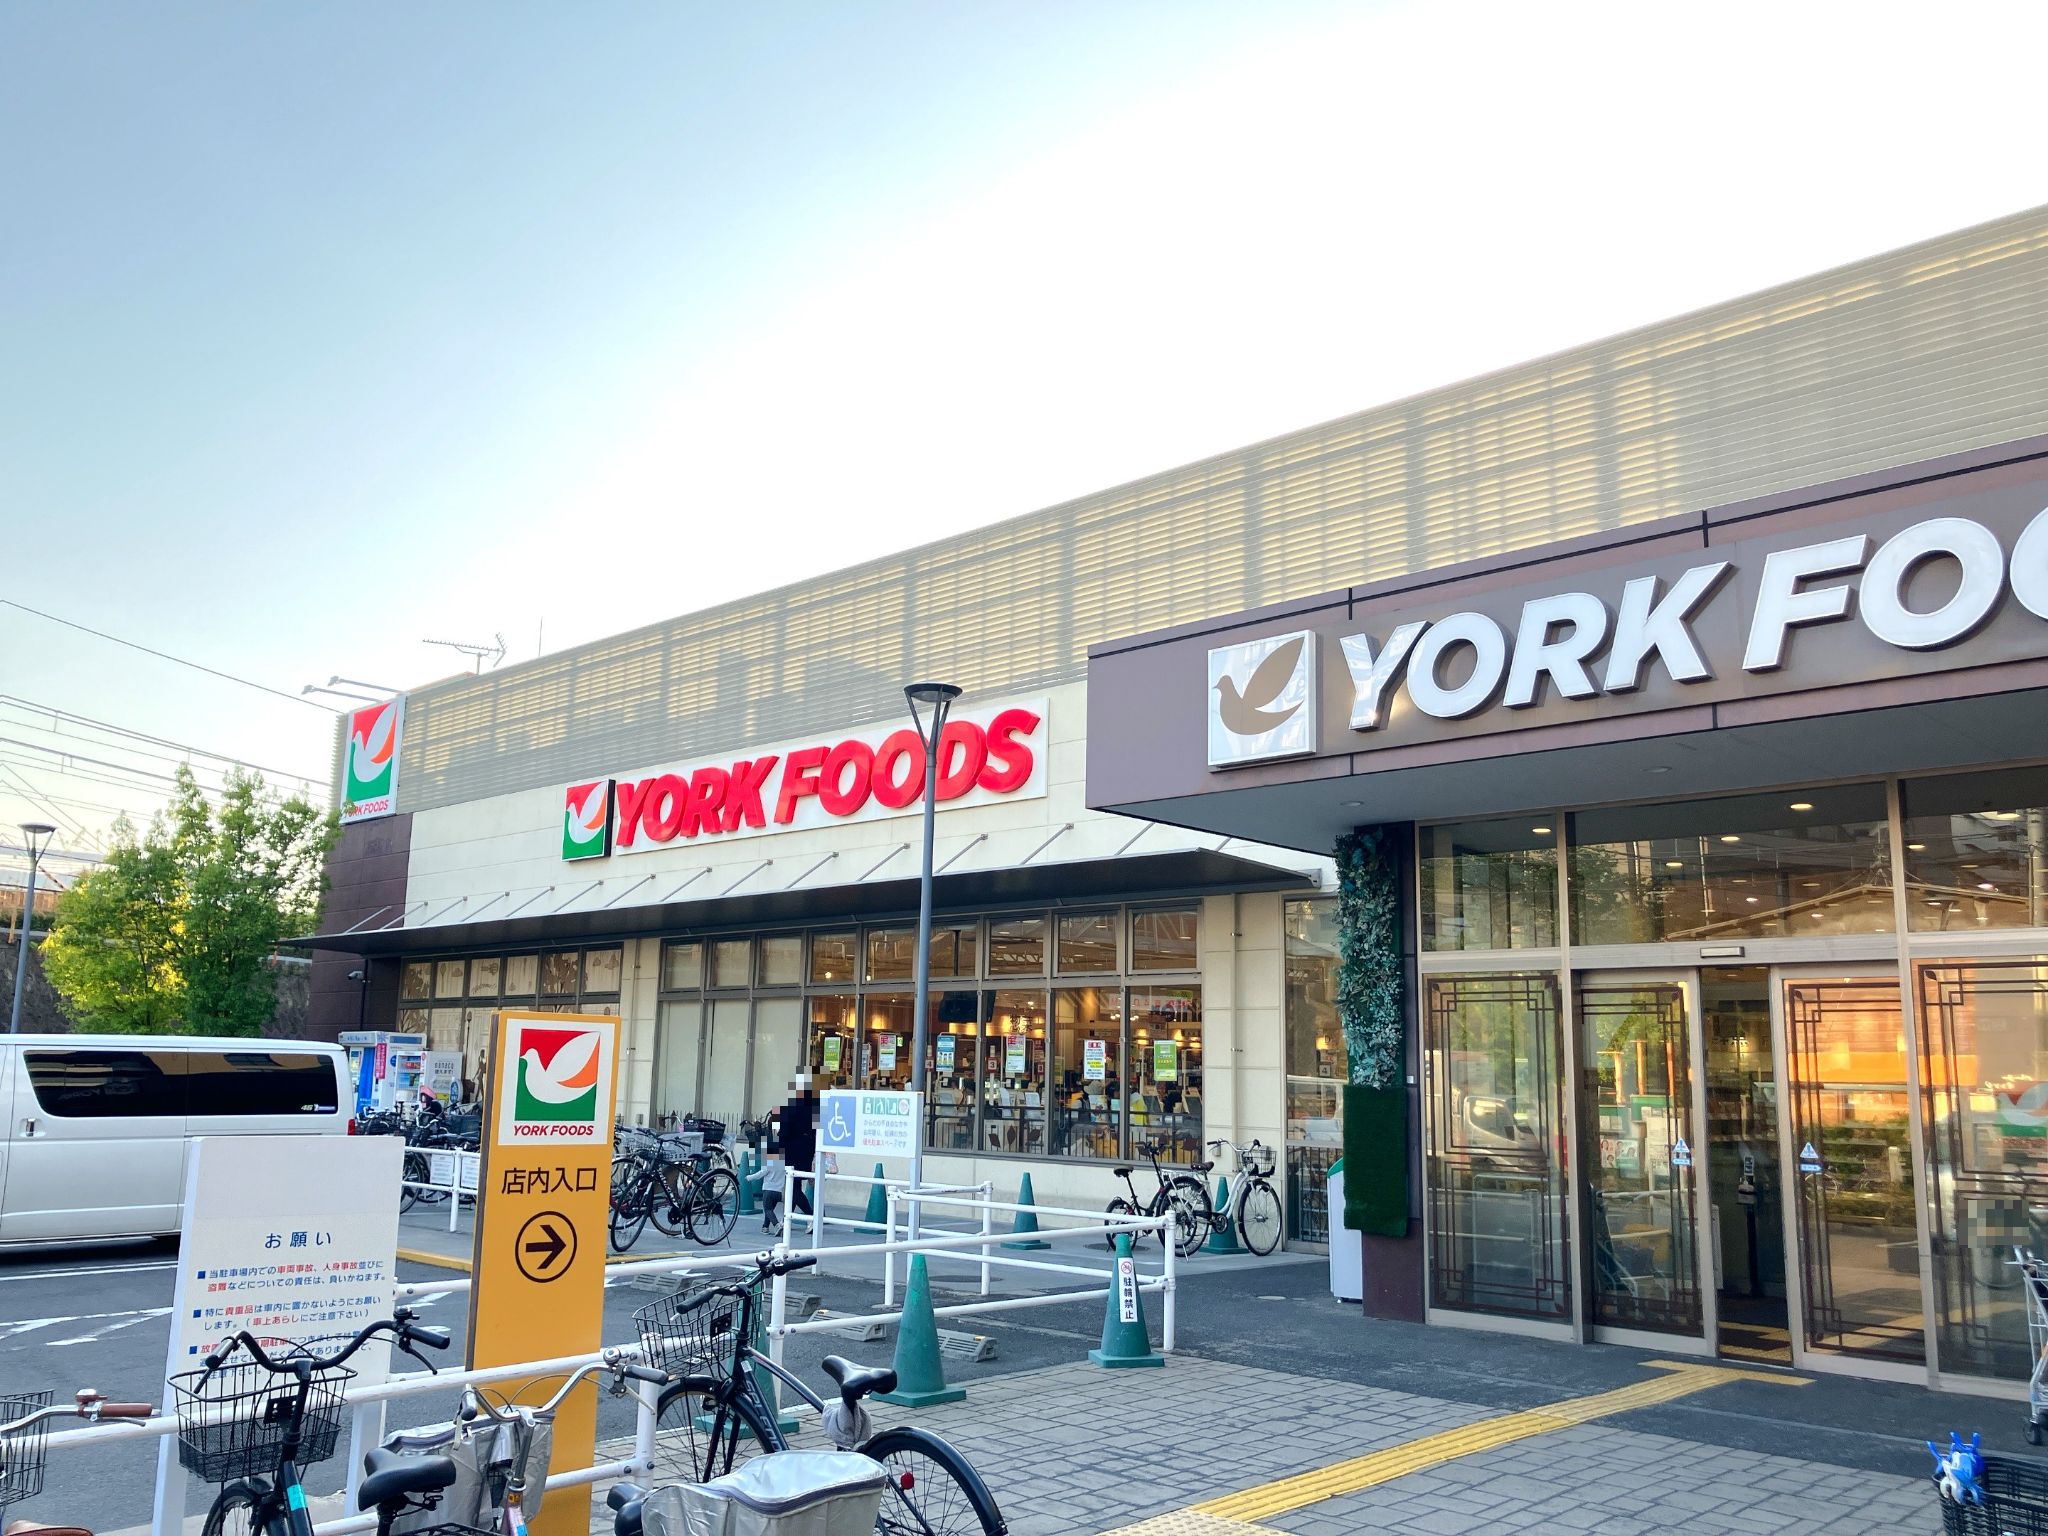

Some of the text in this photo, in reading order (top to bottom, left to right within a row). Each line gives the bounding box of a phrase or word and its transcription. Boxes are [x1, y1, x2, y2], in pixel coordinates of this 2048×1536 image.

[1338, 504, 2048, 732] YORK FO
[616, 708, 1042, 847] YORK FOODS
[363, 800, 389, 814] FOODS
[513, 1125, 594, 1136] YORK FOODS
[501, 1166, 598, 1194] 店内入口
[264, 1231, 332, 1249] お願い
[209, 1261, 384, 1279] 当駐車場内での車両事故、人身事故並びに
[207, 1273, 386, 1292] 盗難などについての責任は、負いかねます。
[205, 1296, 381, 1316] 特に貴重品は車内に置かないようにお願い
[1123, 1277, 1134, 1320] 駐輪禁止
